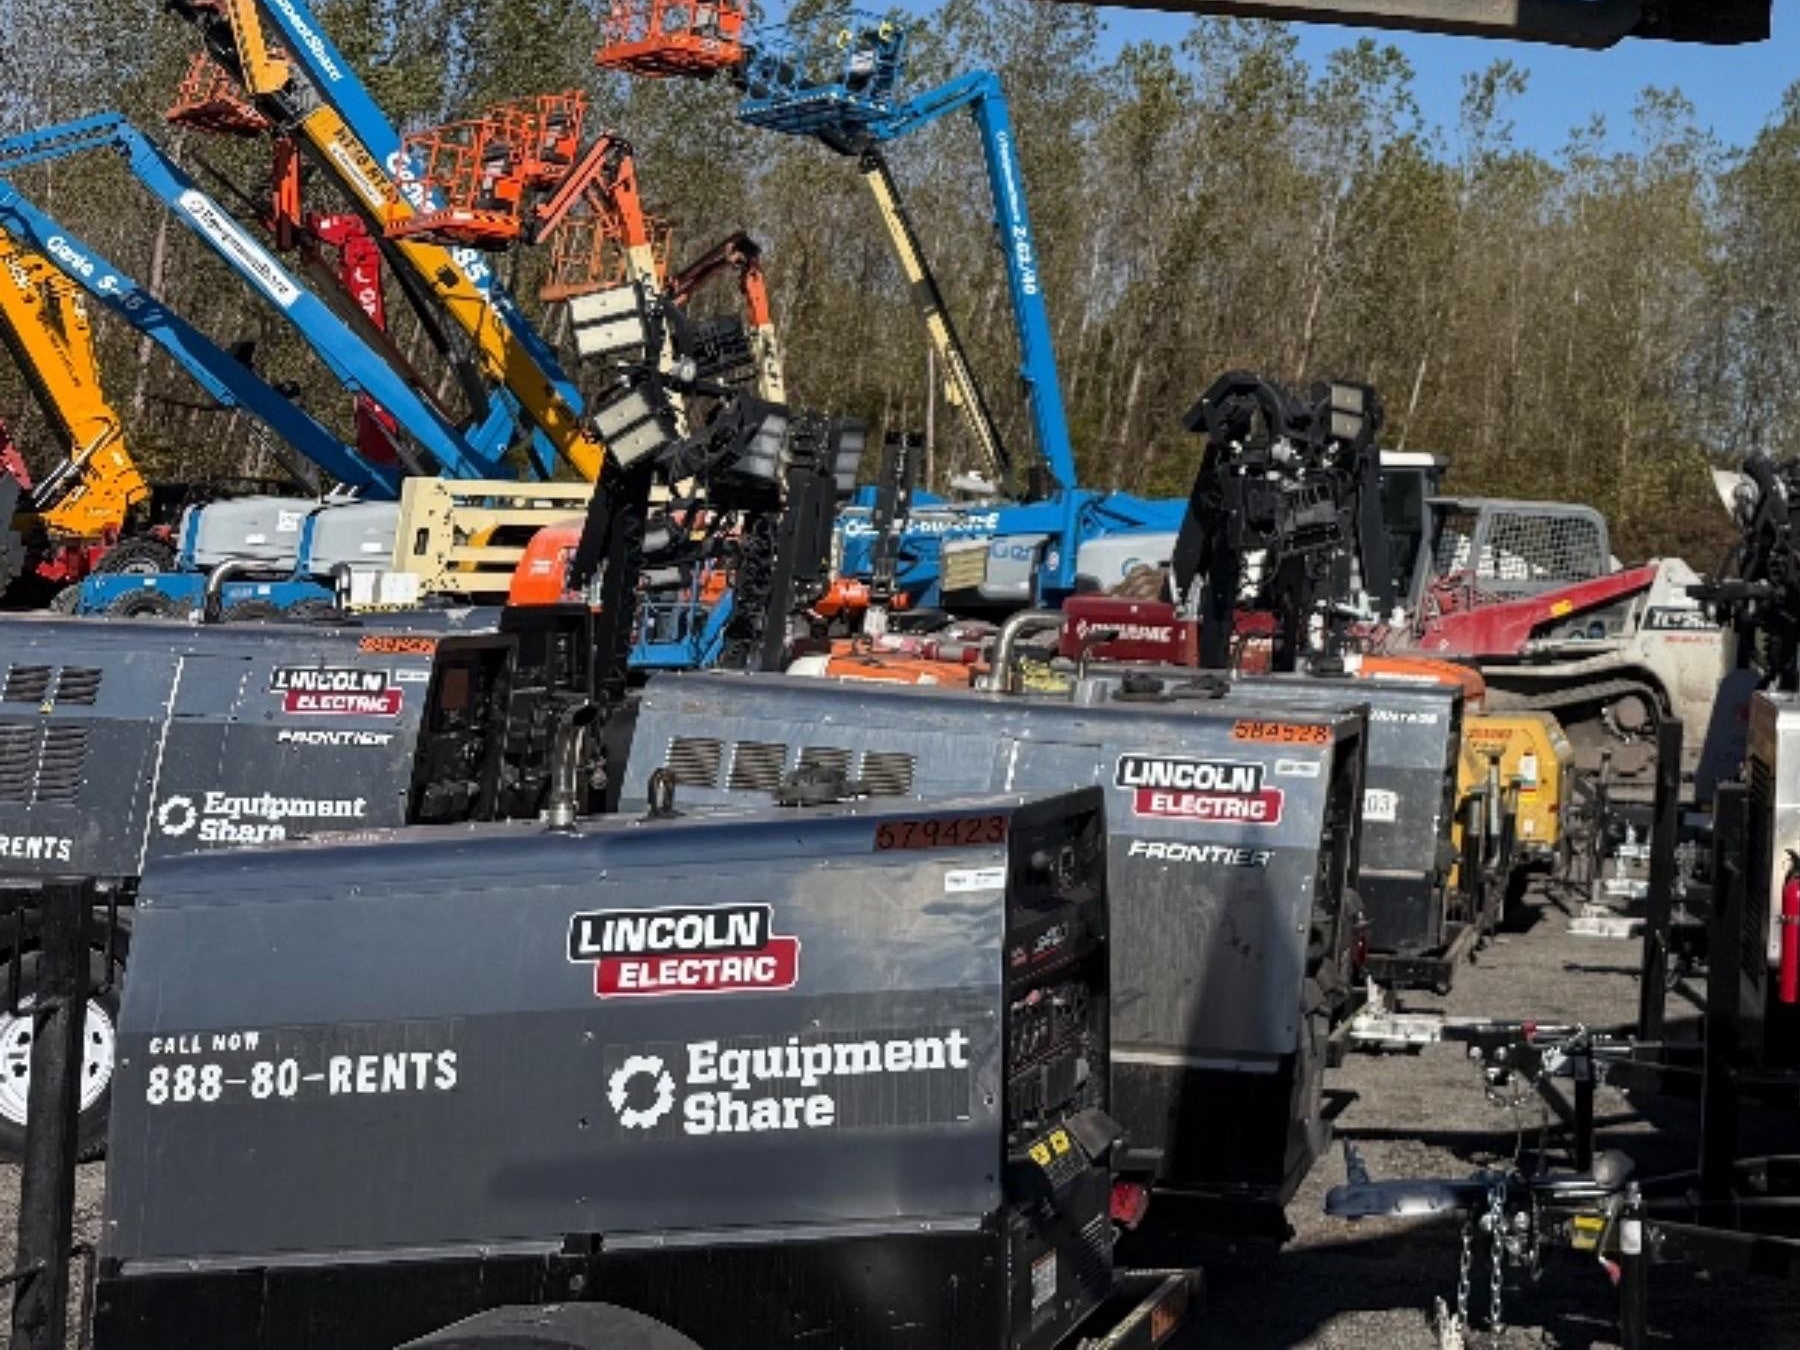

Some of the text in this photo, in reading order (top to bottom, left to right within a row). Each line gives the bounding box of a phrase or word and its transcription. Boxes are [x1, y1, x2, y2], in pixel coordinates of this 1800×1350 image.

[276, 670, 381, 690] LINCOLN
[296, 695, 391, 712] ELECTRIC
[1124, 759, 1255, 793] LINCOLN
[203, 791, 367, 821] Equipment
[1151, 793, 1266, 819] ELECTRIC
[198, 818, 286, 843] Share
[876, 815, 1004, 849] 579423
[1128, 840, 1271, 865] FRONTIER
[578, 910, 760, 953] LINCOLN
[617, 956, 777, 989] ELECTRIC
[149, 1031, 260, 1054] CALL NOW
[686, 1028, 969, 1087] Equipment
[146, 1049, 459, 1105] 888-80-RENTS
[683, 1090, 835, 1136] Share
